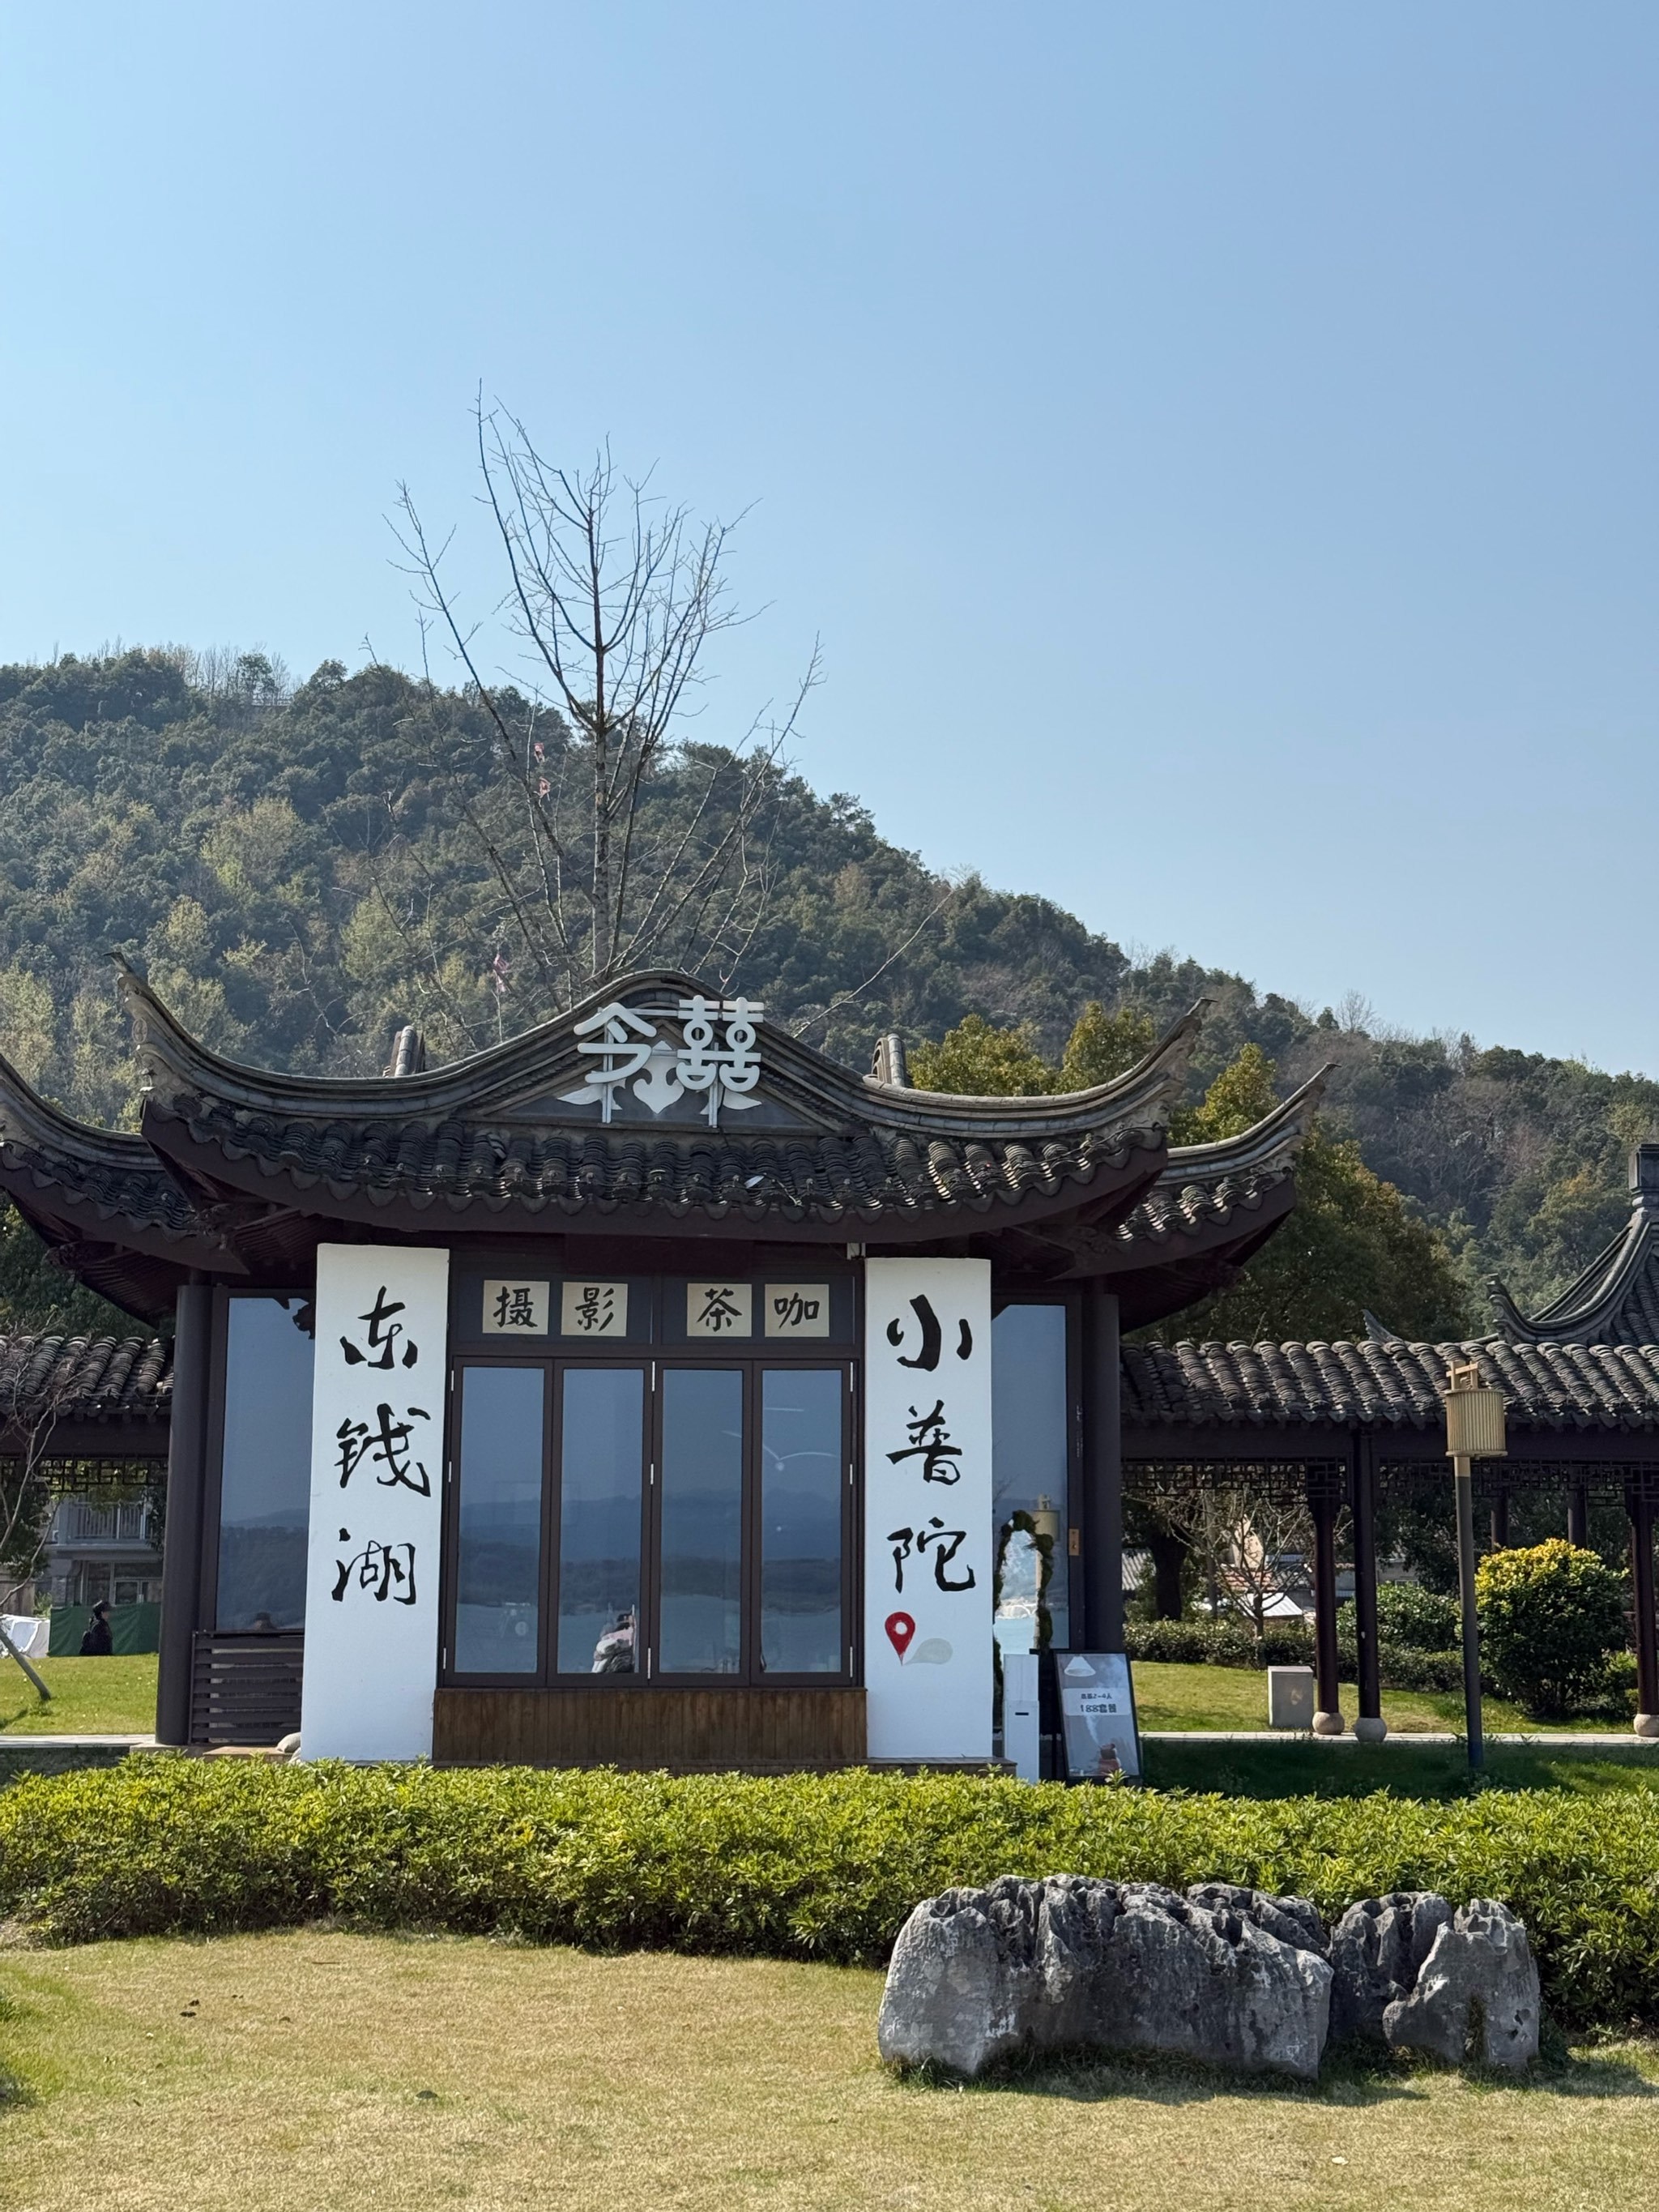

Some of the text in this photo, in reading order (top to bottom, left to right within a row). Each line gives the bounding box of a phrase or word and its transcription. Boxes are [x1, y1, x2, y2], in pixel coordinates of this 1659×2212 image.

[331, 1285, 432, 1607] 东钱湖
[493, 1286, 820, 1331] 摄影 茶咖
[885, 1294, 976, 1594] 小普陀
